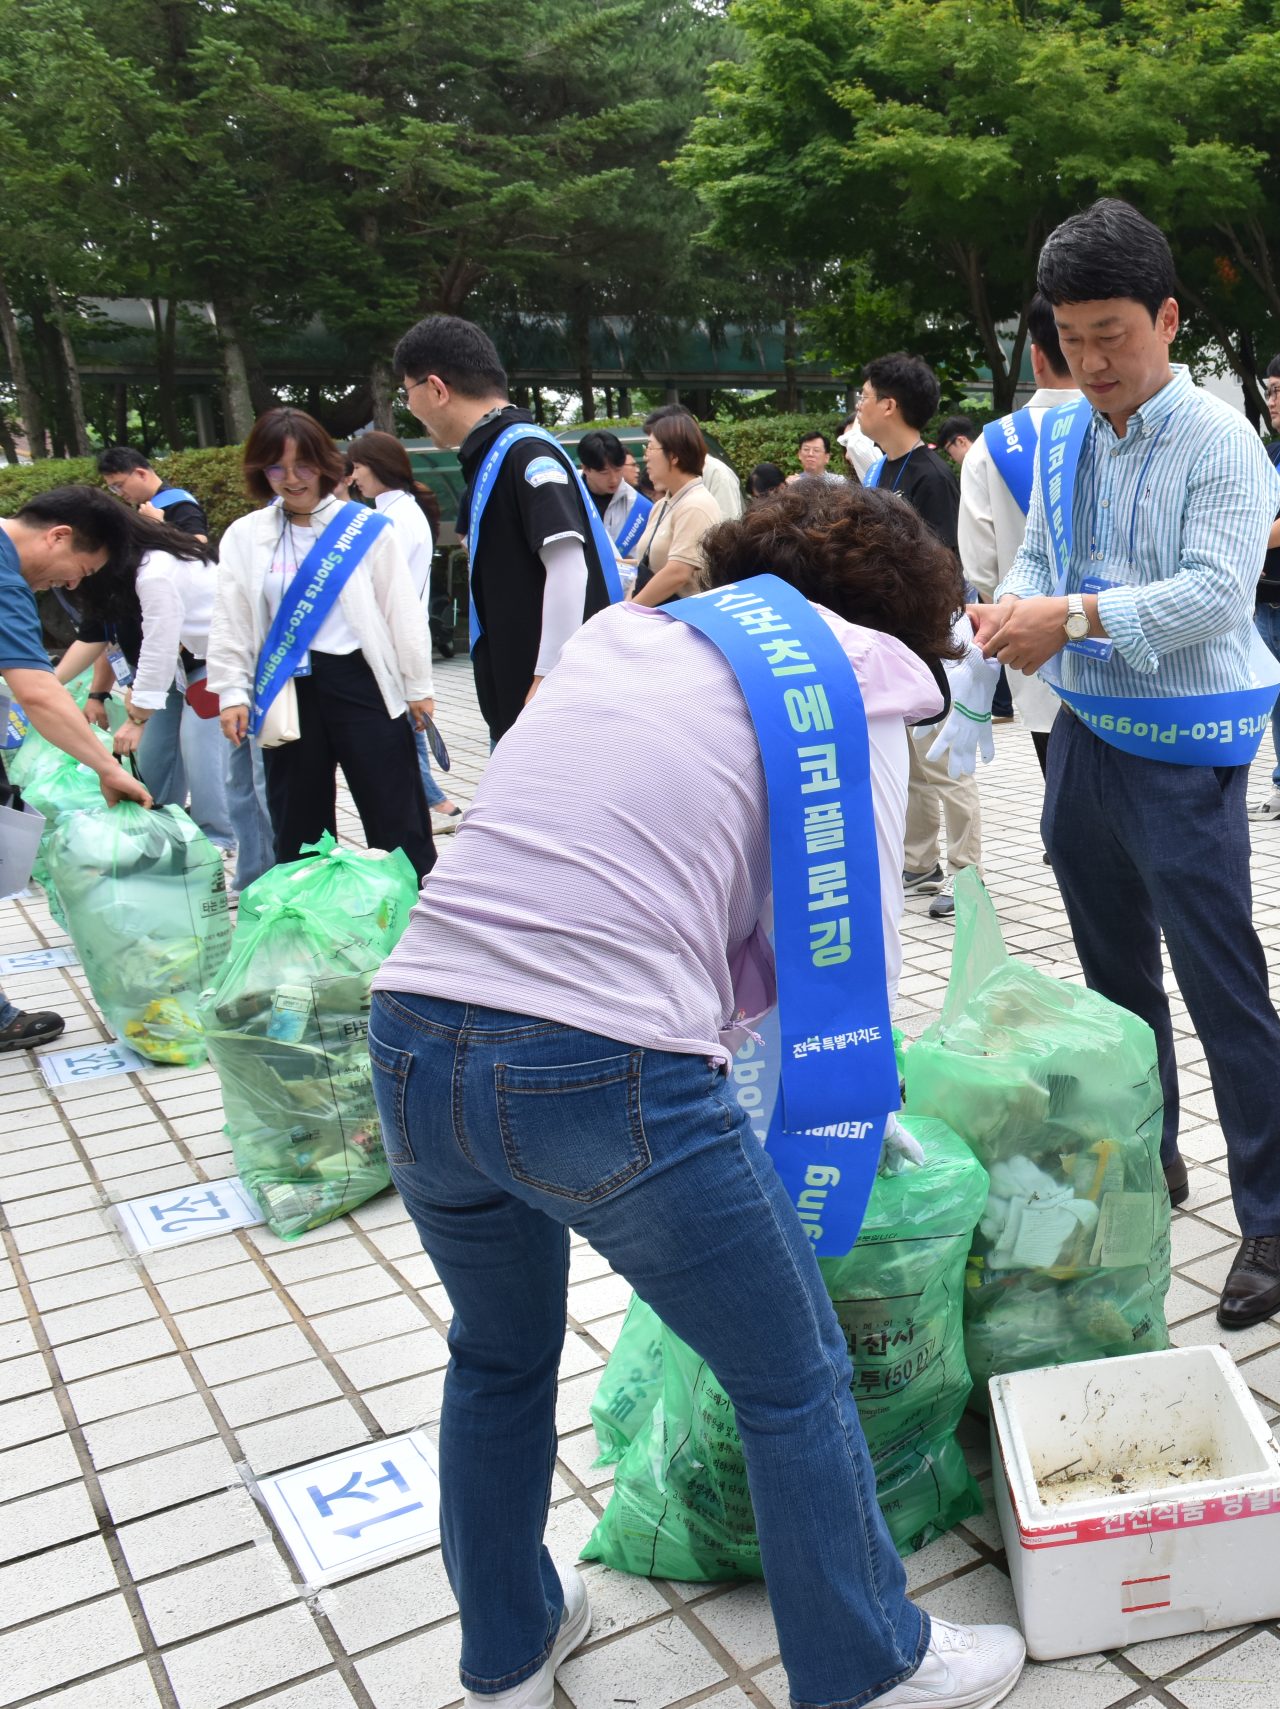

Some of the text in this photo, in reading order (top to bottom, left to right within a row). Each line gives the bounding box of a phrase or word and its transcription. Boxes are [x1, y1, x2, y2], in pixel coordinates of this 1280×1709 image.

[622, 513, 645, 548] Jeonbuk
[304, 551, 343, 600] Sports
[256, 598, 314, 696] Eco-Plogging
[65, 1049, 126, 1076] 3조
[792, 1026, 882, 1059] 전북특별자치도
[149, 1190, 231, 1232] 2조
[306, 1460, 424, 1539] 1조
